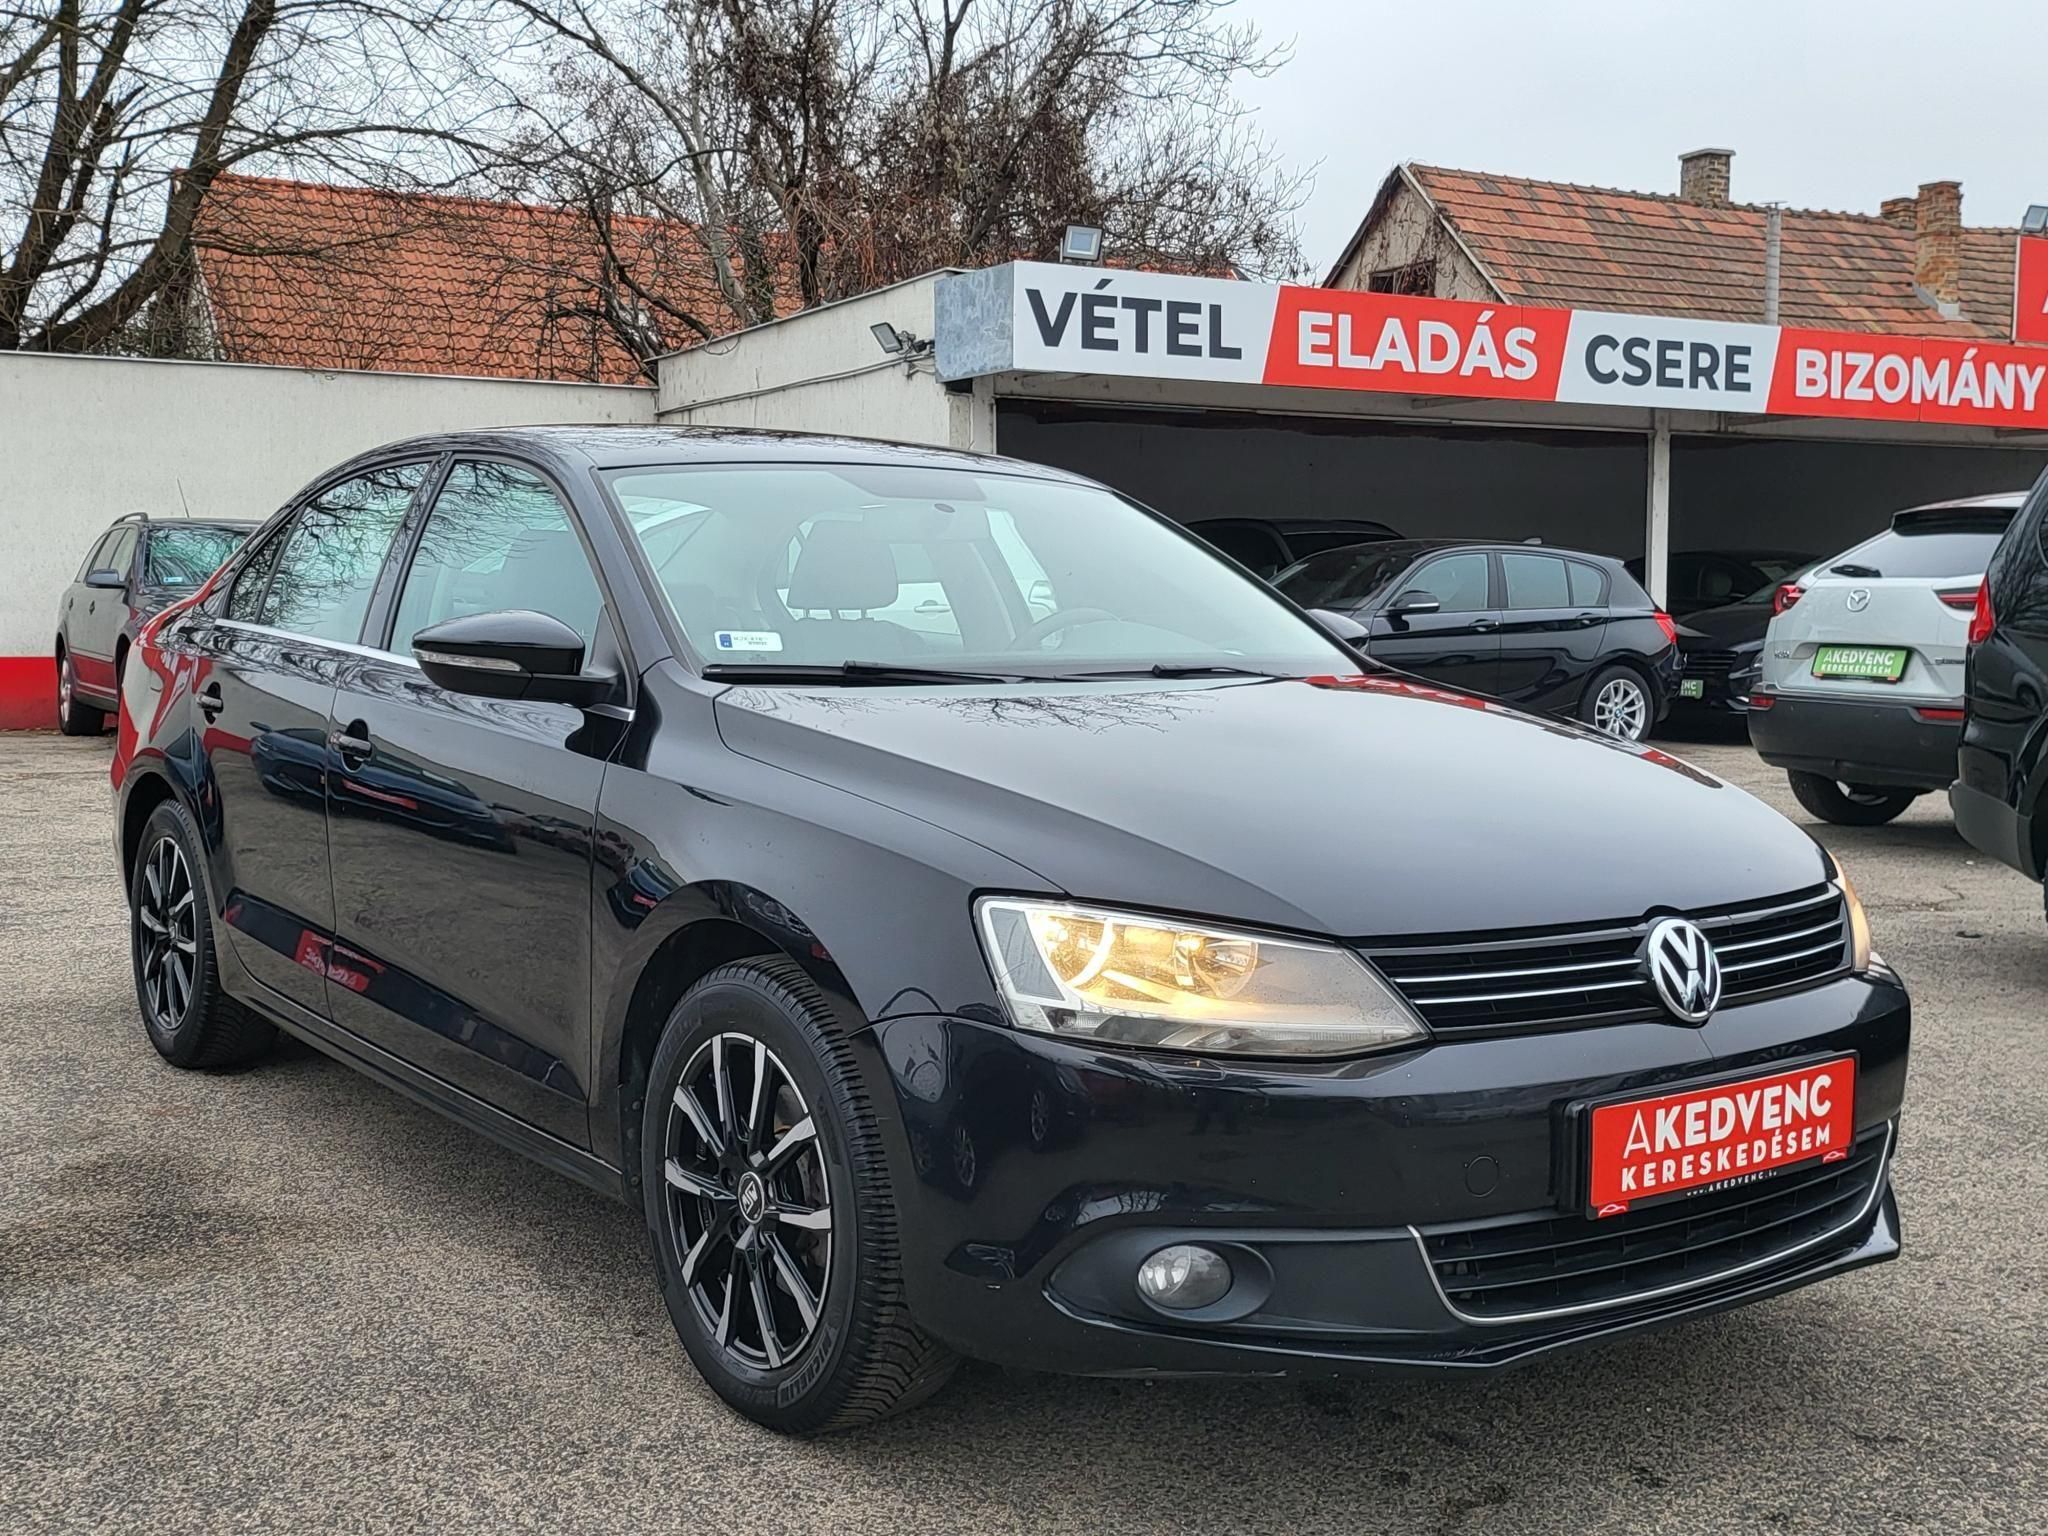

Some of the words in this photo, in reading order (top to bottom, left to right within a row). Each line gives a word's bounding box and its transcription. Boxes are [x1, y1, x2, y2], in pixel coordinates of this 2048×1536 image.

[1025, 279, 1242, 360] VÉTEL
[1297, 310, 1538, 380] ELADÁS
[1584, 334, 1752, 392] CSERE
[1795, 347, 2047, 411] BIZOMÁNY
[1621, 1123, 1831, 1192] KERESKEDÉSEM
